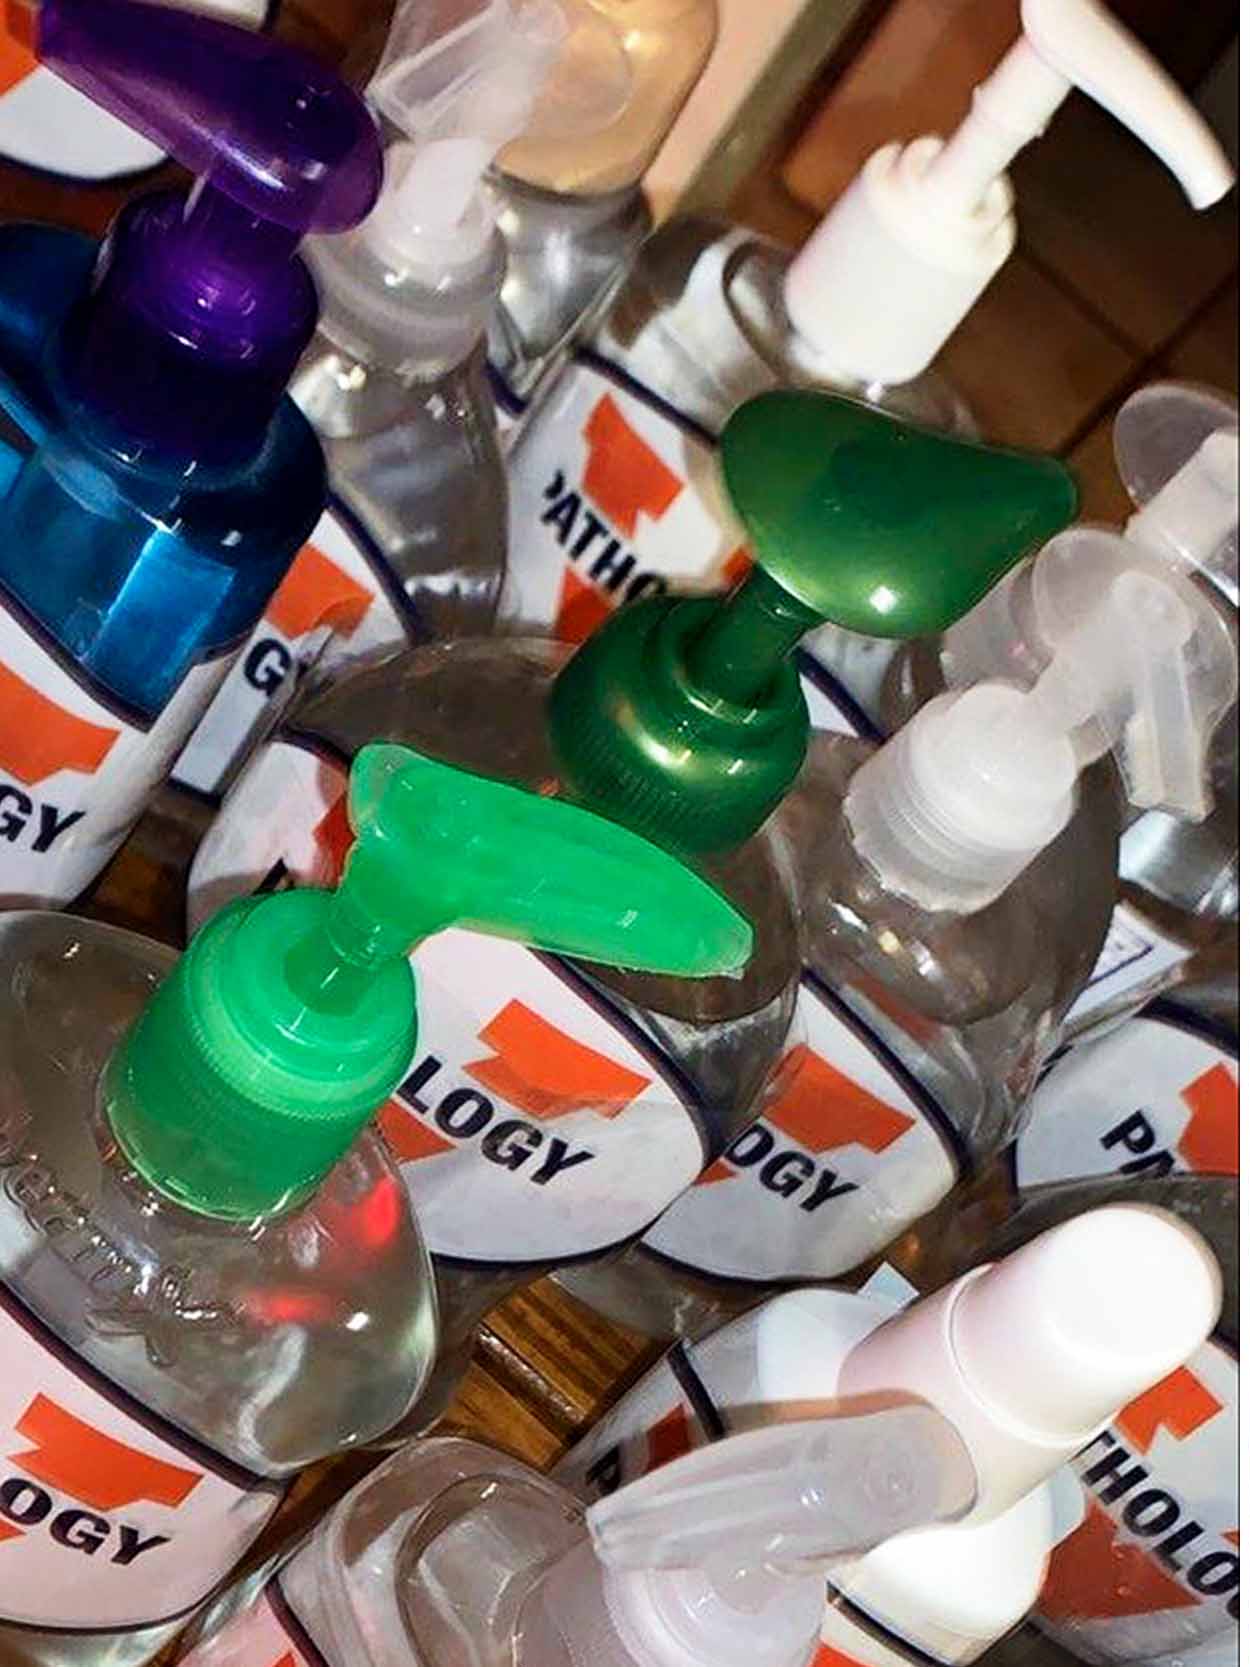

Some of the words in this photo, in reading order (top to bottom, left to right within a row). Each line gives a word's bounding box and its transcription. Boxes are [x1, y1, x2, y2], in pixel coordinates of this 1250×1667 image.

[396, 1055, 595, 1185] LOGY
[1099, 1109, 1185, 1178] PA
[0, 1478, 171, 1565] OGY
